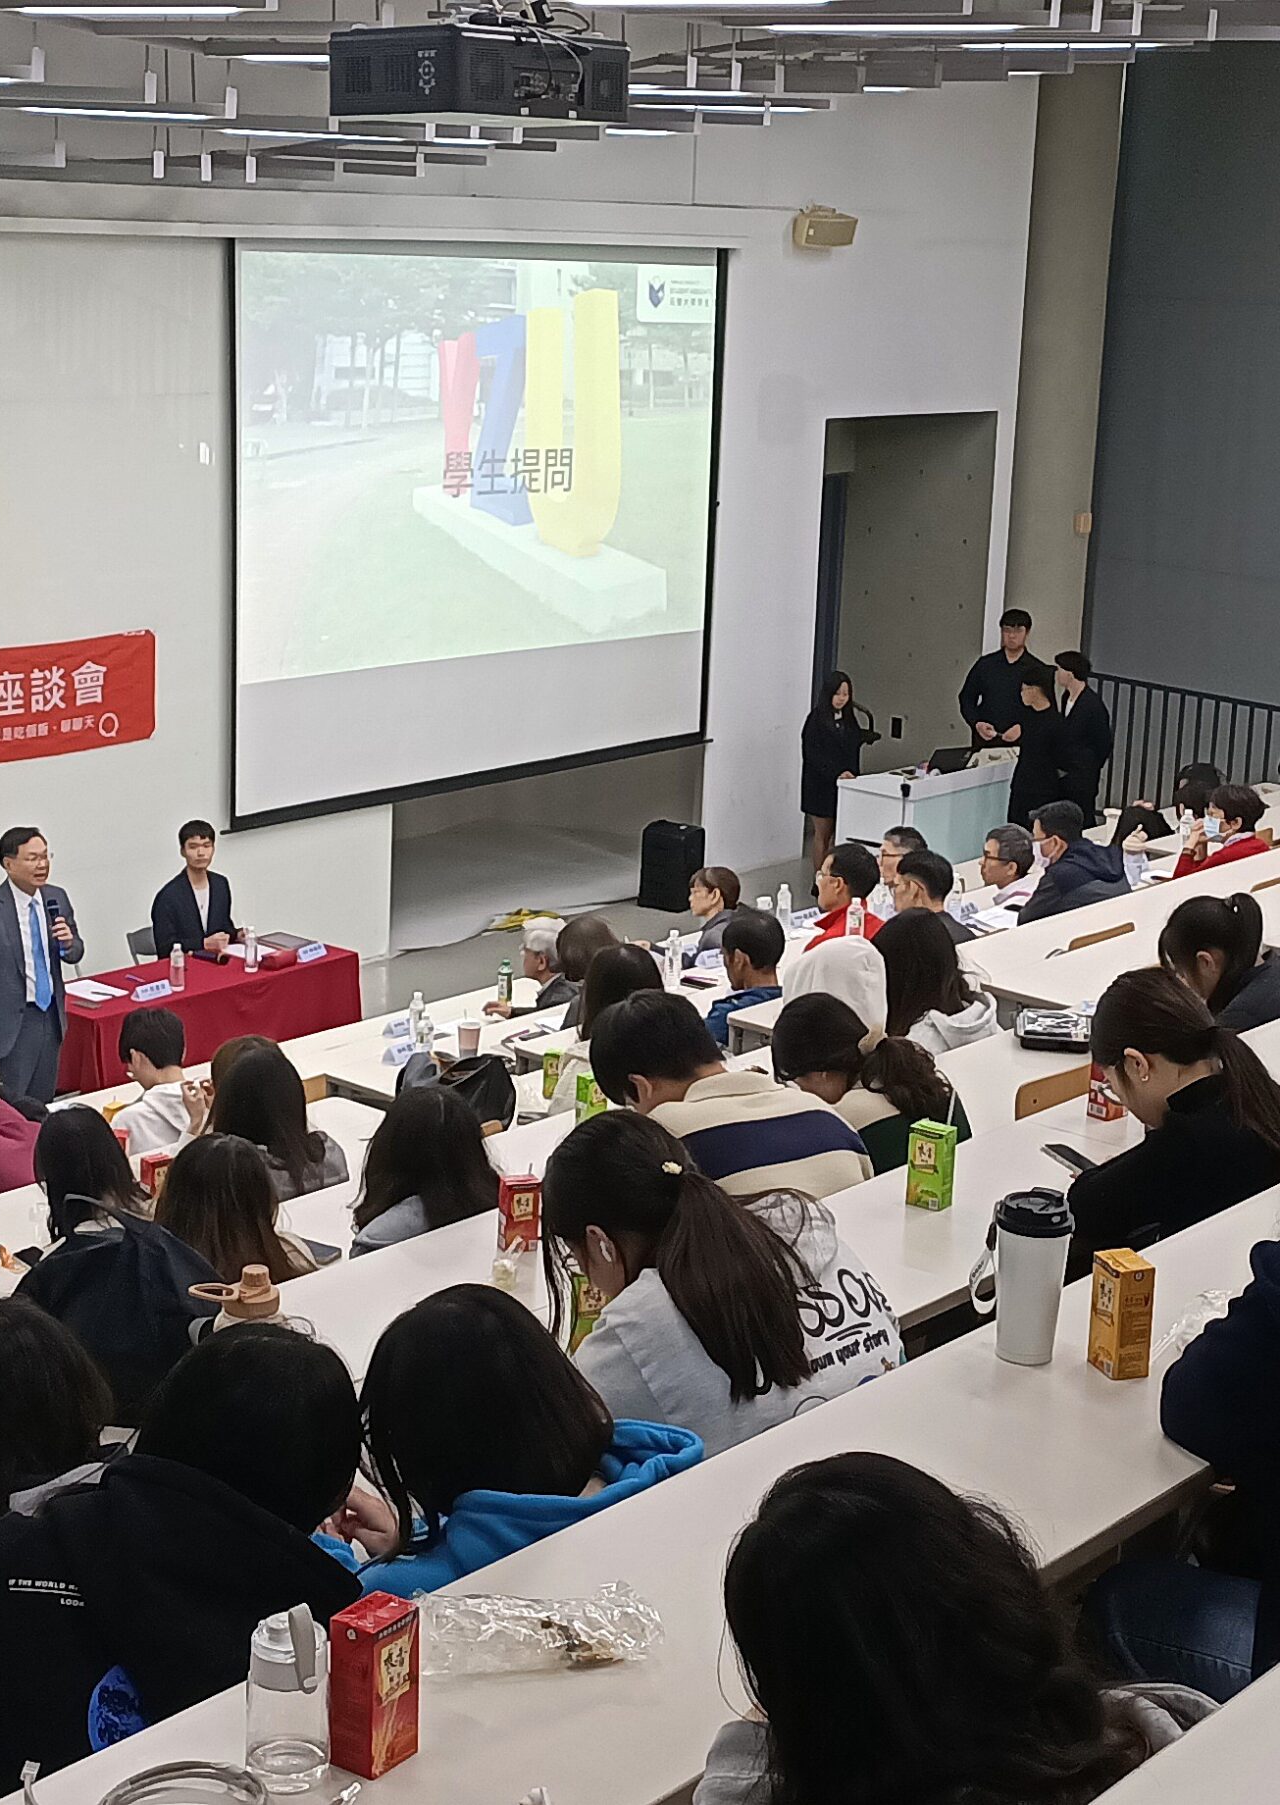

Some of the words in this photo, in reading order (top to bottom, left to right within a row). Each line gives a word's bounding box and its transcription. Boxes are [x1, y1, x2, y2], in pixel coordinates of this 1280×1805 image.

[442, 447, 574, 498] 學生提問
[835, 1339, 861, 1366] your
[862, 1329, 890, 1353] story
[34, 1580, 66, 1589] WORLD
